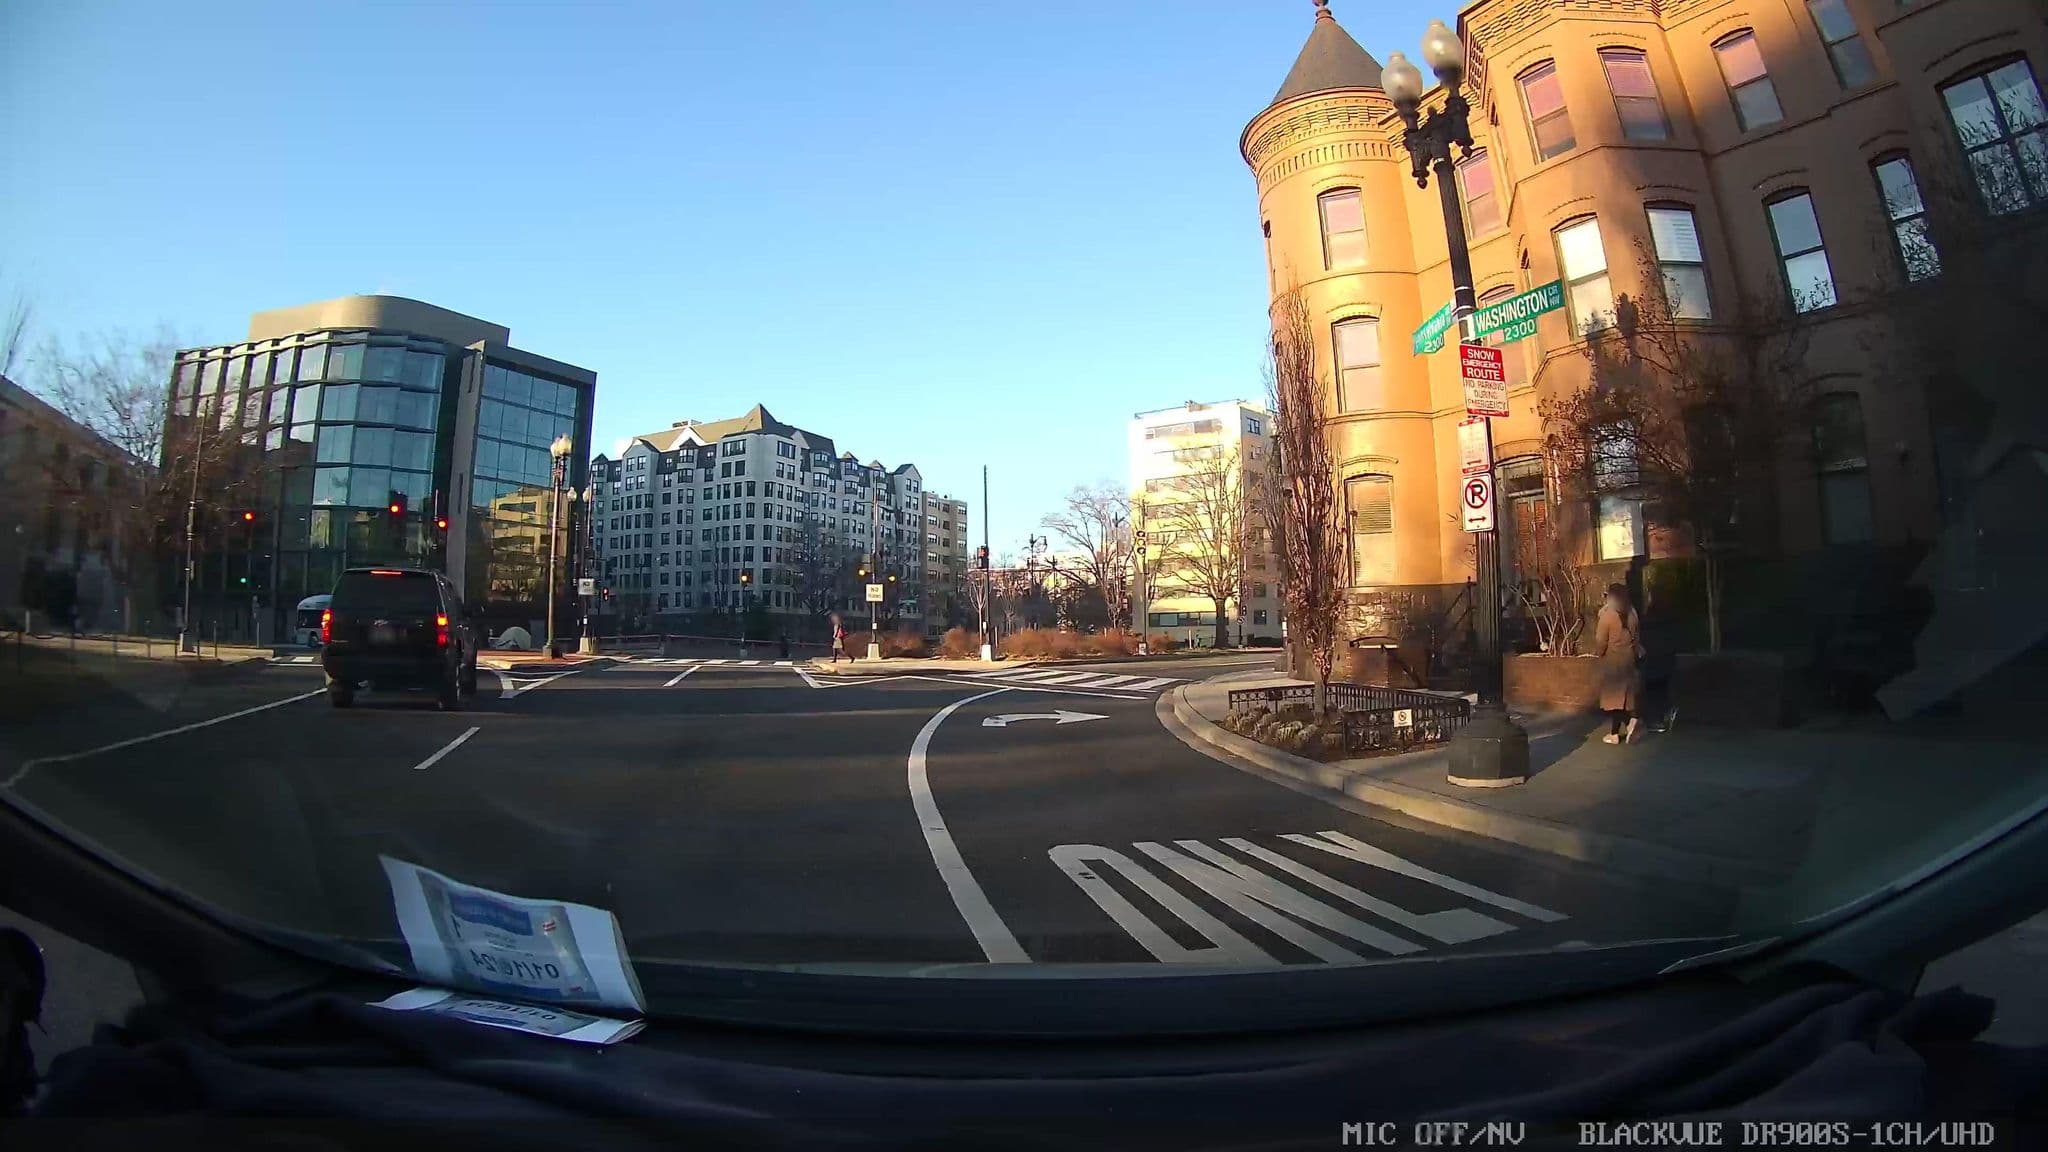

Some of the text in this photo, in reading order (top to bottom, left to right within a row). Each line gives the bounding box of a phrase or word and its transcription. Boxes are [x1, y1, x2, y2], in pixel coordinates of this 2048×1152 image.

[1549, 296, 1560, 306] NW
[1475, 289, 1549, 333] WASHINGTON
[1548, 285, 1559, 296] CIR
[1504, 318, 1535, 341] 2300
[1467, 348, 1495, 361] SNOW
[1462, 358, 1502, 370] EMERGENCY
[1466, 367, 1501, 380] ROUTE
[1464, 379, 1505, 391] NO PARKING
[1473, 389, 1498, 400] DURING
[1467, 398, 1506, 410] EMERGENCY
[1048, 830, 1574, 964] ONLY
